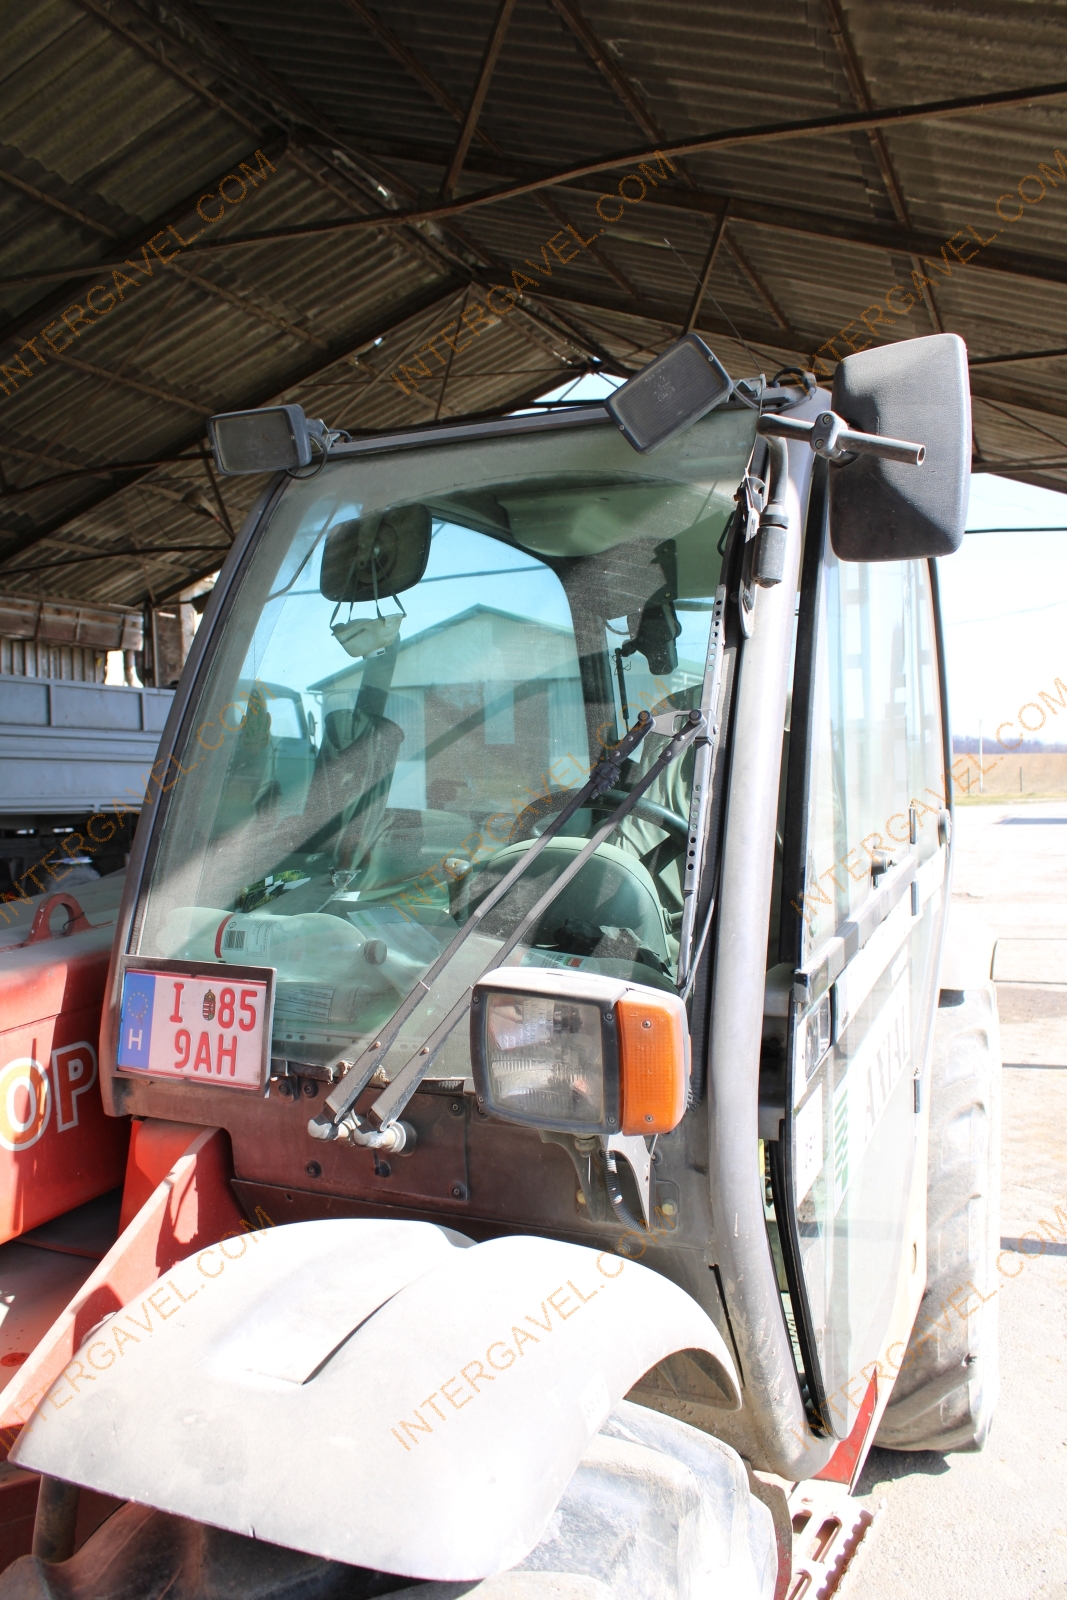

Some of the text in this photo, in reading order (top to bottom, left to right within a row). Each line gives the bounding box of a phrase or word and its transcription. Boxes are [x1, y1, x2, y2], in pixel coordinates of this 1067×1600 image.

[217, 988, 258, 1032] 85
[128, 1028, 143, 1051] H
[174, 1029, 237, 1076] 9AH
